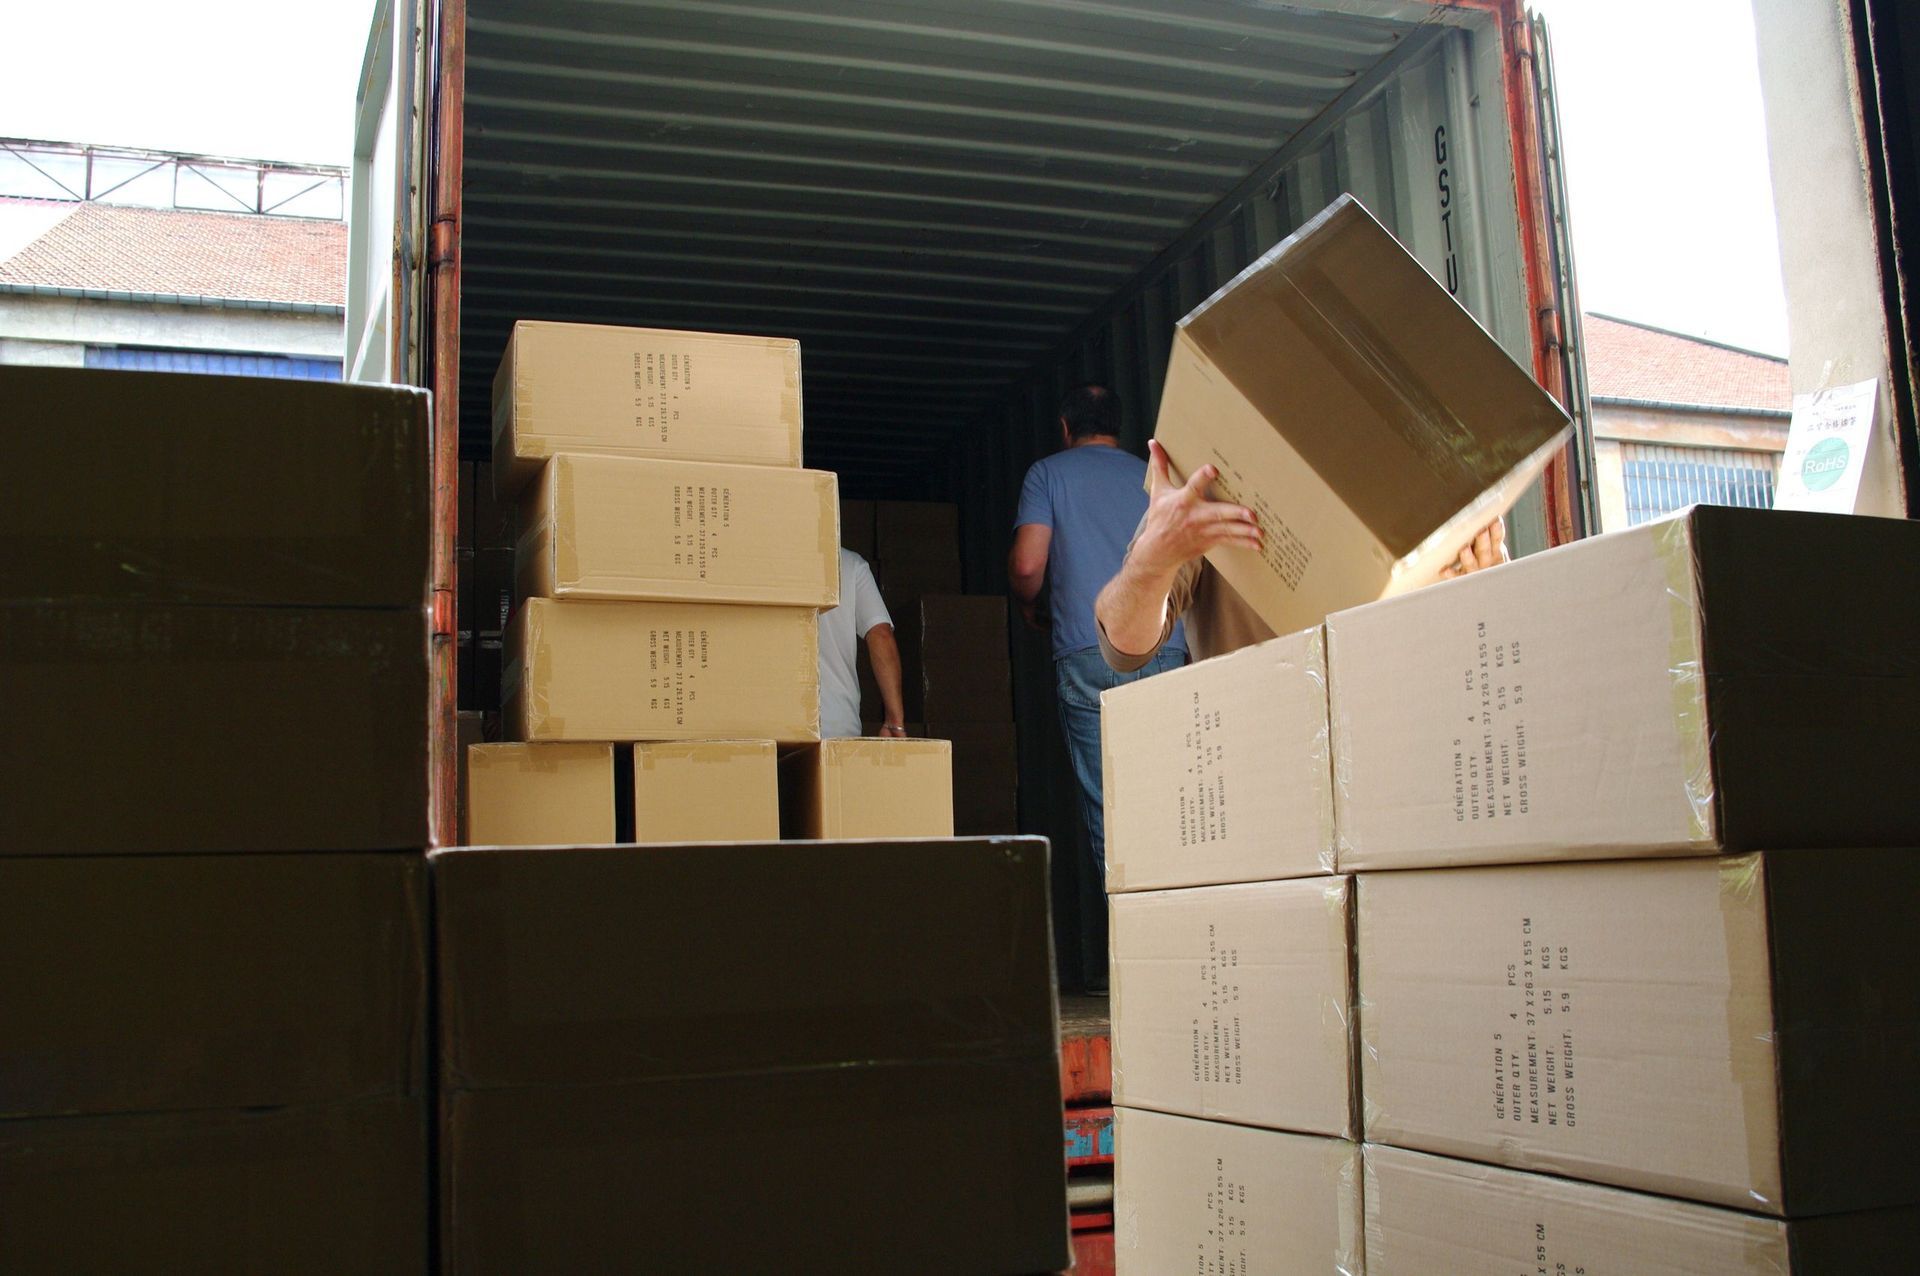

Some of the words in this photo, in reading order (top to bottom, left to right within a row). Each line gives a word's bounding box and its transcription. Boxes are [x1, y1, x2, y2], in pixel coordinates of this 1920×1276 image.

[1435, 125, 1458, 296] GSTU
[1805, 455, 1846, 474] RoHS
[1478, 622, 1486, 638] CM
[1479, 643, 1487, 658] 55
[1495, 645, 1504, 668] KGS
[1512, 641, 1521, 664] KGS
[1465, 669, 1474, 691] PCS
[1497, 686, 1506, 710] 5.15
[1514, 685, 1523, 704] 5.9
[1482, 712, 1491, 725] 37
[1470, 784, 1479, 820] OUTER
[1502, 794, 1511, 816] NET
[1518, 775, 1528, 813] GROSS
[1523, 917, 1531, 934] CM
[1523, 940, 1532, 956] 55
[1541, 946, 1550, 970] KGS
[1559, 946, 1569, 970] KGS
[1507, 964, 1516, 986] PCS
[1524, 971, 1534, 996] 26.3
[1543, 990, 1552, 1014] 5.15
[1561, 992, 1570, 1012] 5.9
[1526, 1012, 1535, 1026] 37
[1512, 1084, 1521, 1121] OUTER
[1565, 1087, 1575, 1127] GROSS
[1547, 1103, 1557, 1125] NET
[1536, 1224, 1545, 1240] CM
[1537, 1246, 1546, 1261] 55
